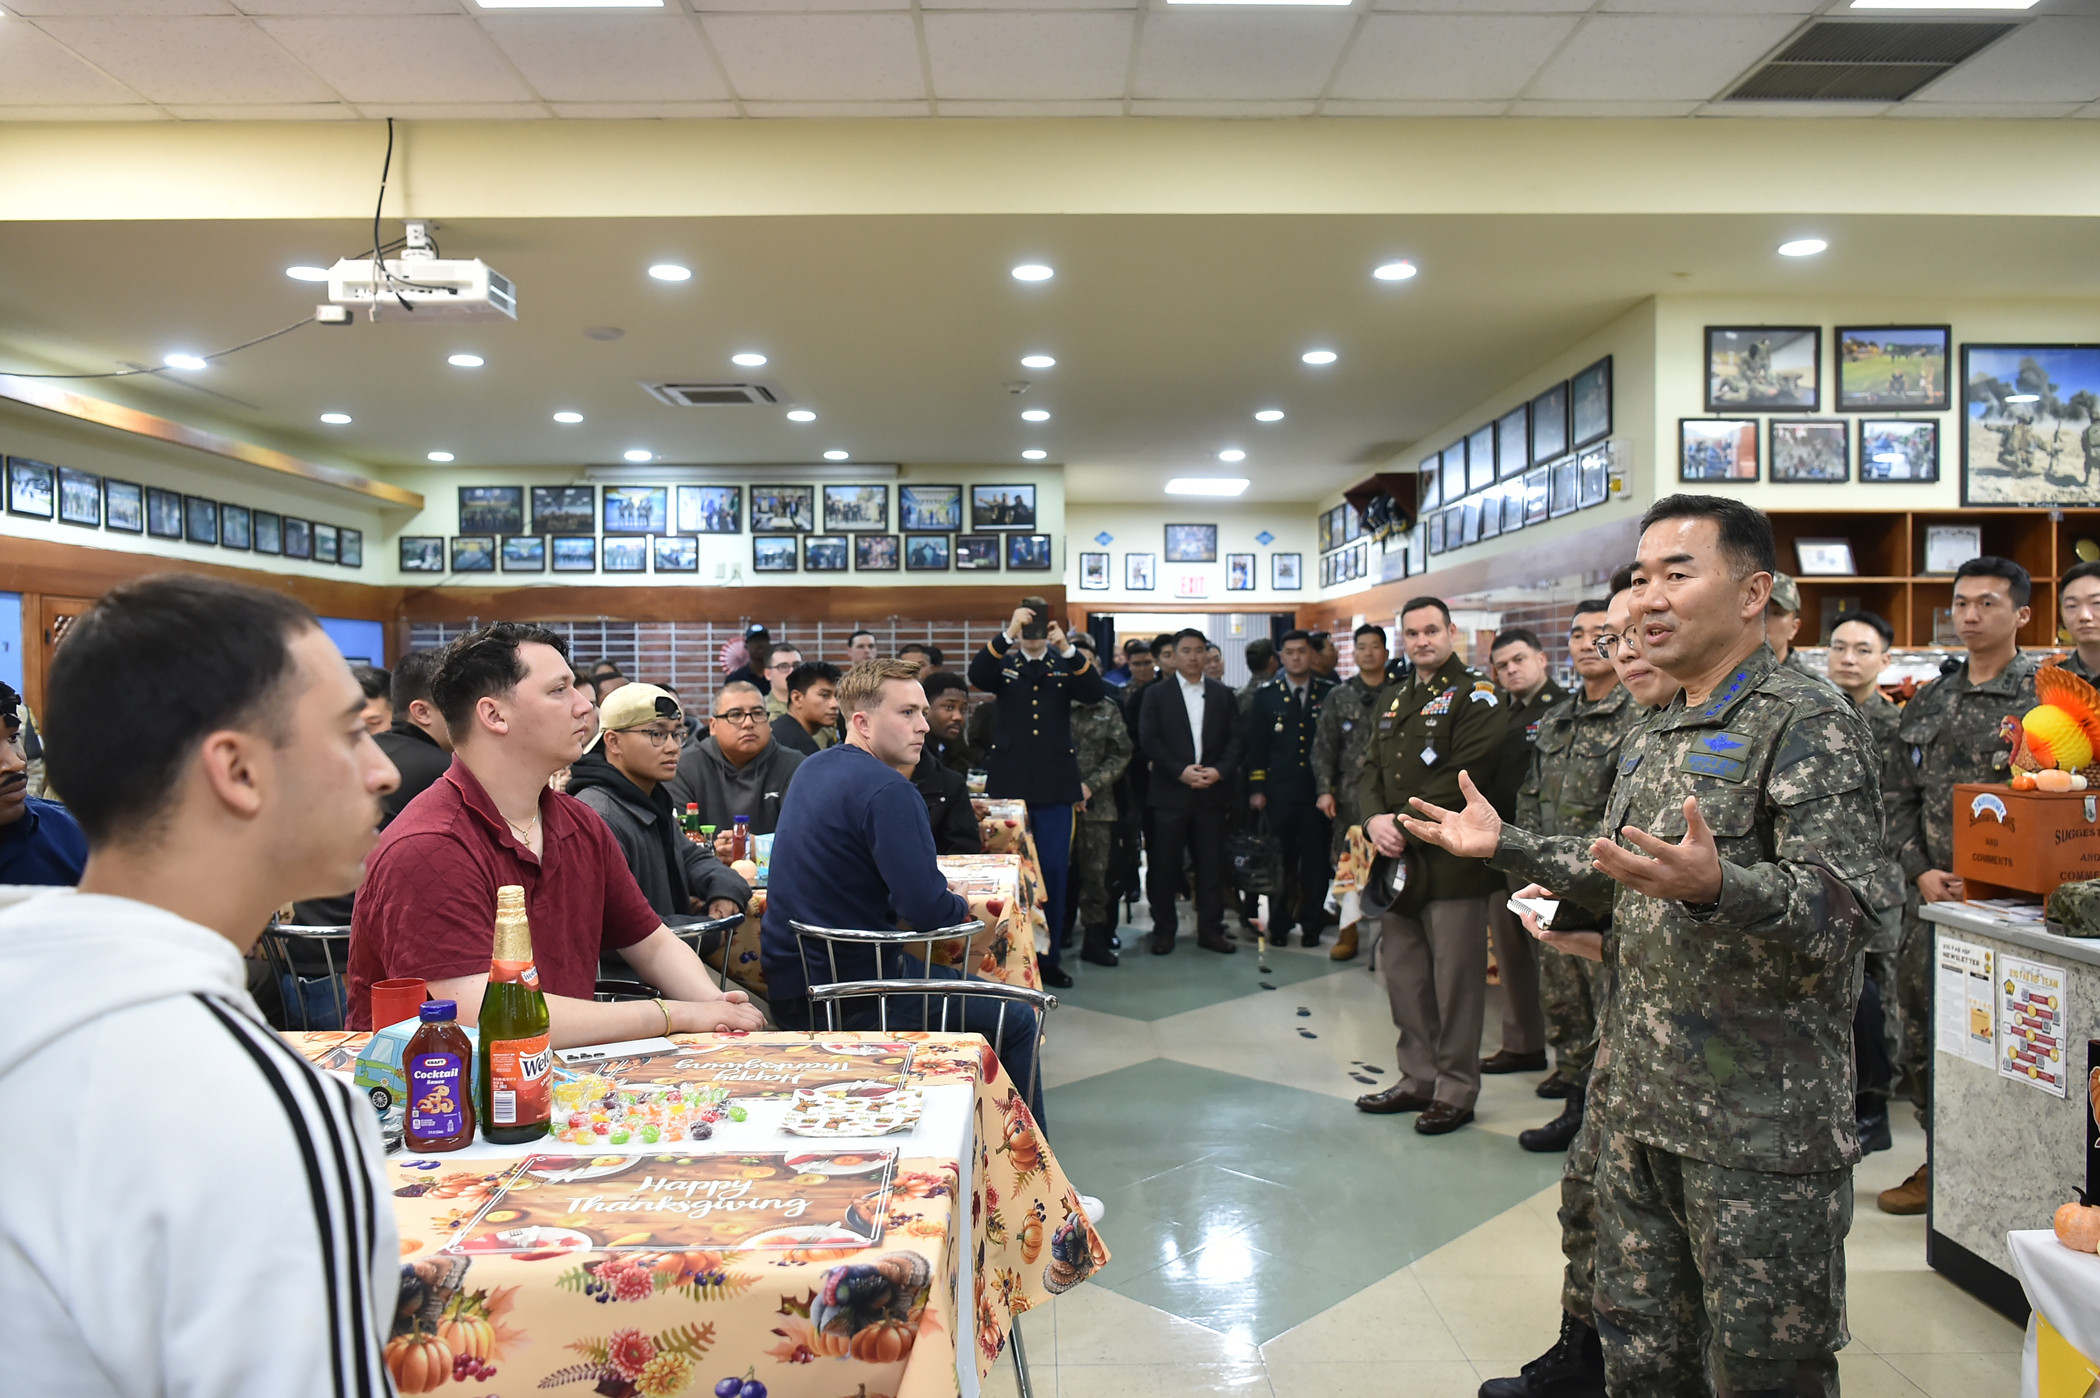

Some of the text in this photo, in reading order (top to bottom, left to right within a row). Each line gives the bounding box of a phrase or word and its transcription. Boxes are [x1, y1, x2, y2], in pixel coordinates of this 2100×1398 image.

[1181, 576, 1205, 594] EXIT
[1985, 838, 1998, 847] AND
[1972, 854, 2013, 868] COMMENTS
[1942, 951, 1980, 966] NEWSLETTER
[2041, 974, 2059, 988] TEAM
[673, 1058, 850, 1073] Thanksgiving
[414, 1067, 459, 1080] Cocktail
[712, 1068, 806, 1085] Happy
[633, 1175, 754, 1200] Happy
[566, 1194, 813, 1219] Thanksgiving
